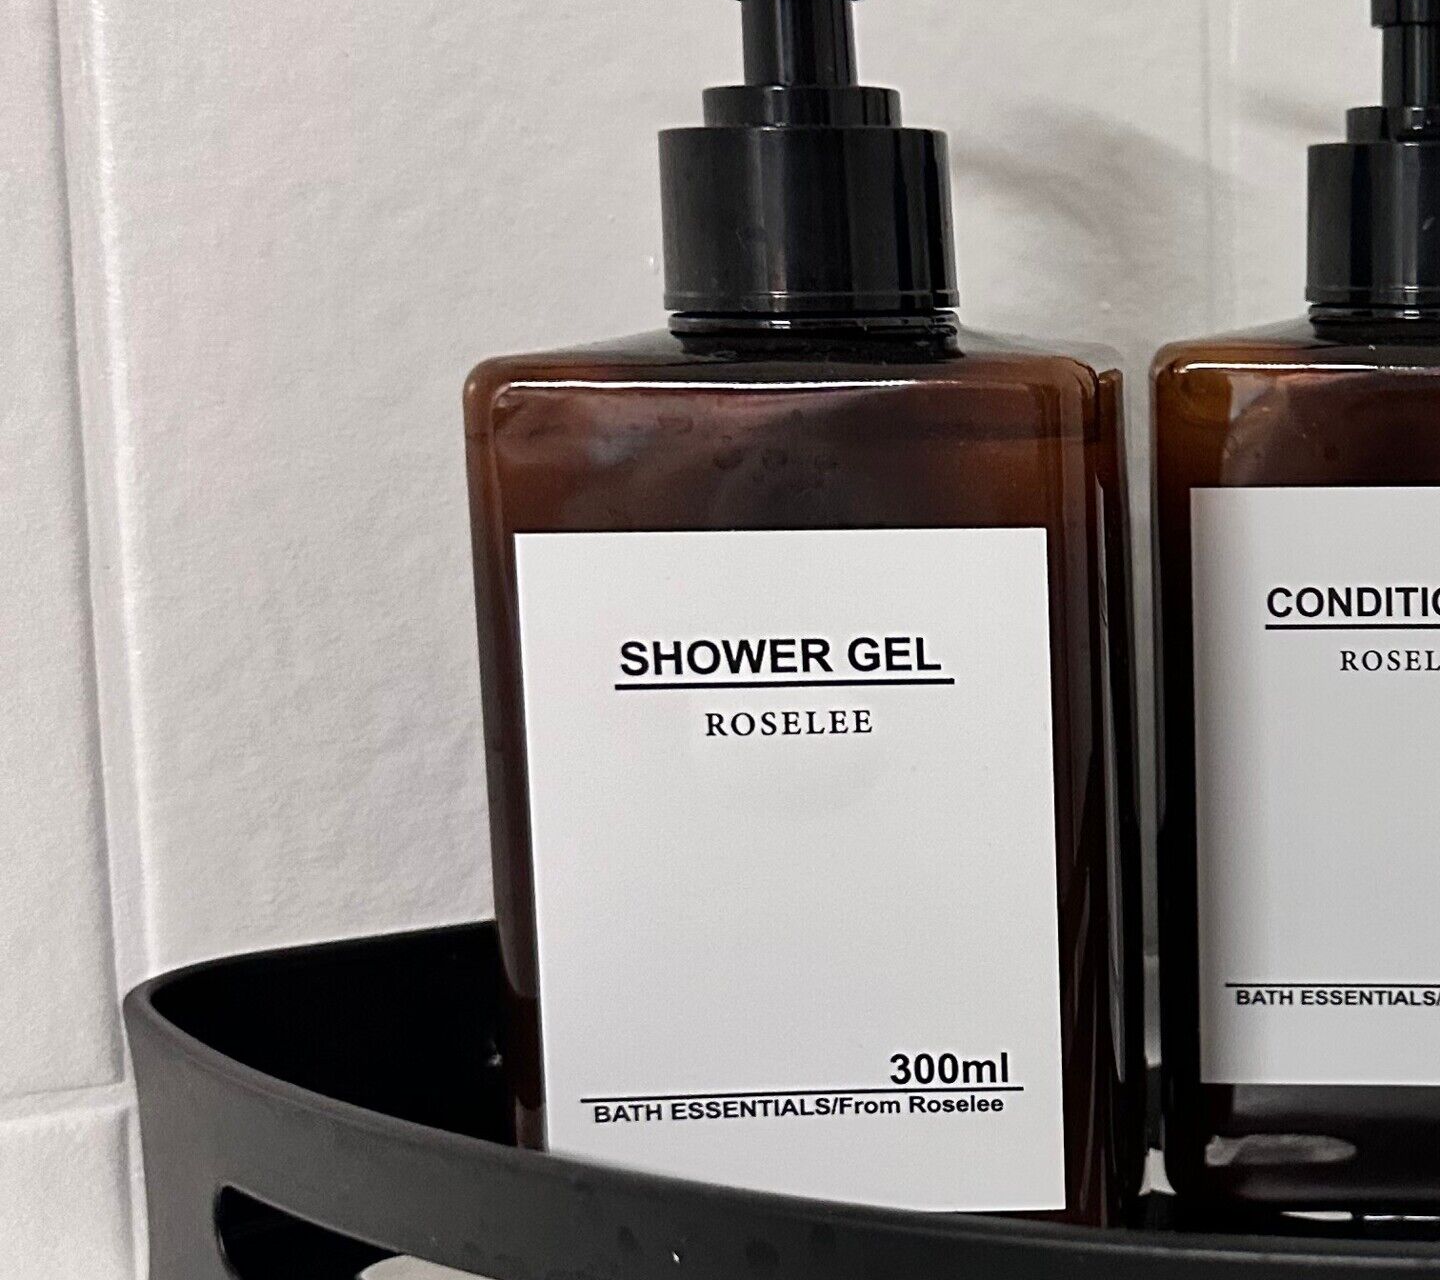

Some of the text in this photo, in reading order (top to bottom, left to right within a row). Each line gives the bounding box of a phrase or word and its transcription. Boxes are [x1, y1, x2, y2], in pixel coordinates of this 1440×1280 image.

[619, 635, 943, 677] SHOWER GEL
[705, 709, 874, 739] ROSELEE
[1235, 989, 1294, 1007] BATH
[889, 1051, 1010, 1085] 300ml
[593, 1094, 1005, 1124] BATH ESSENTIALS/From Roselee
